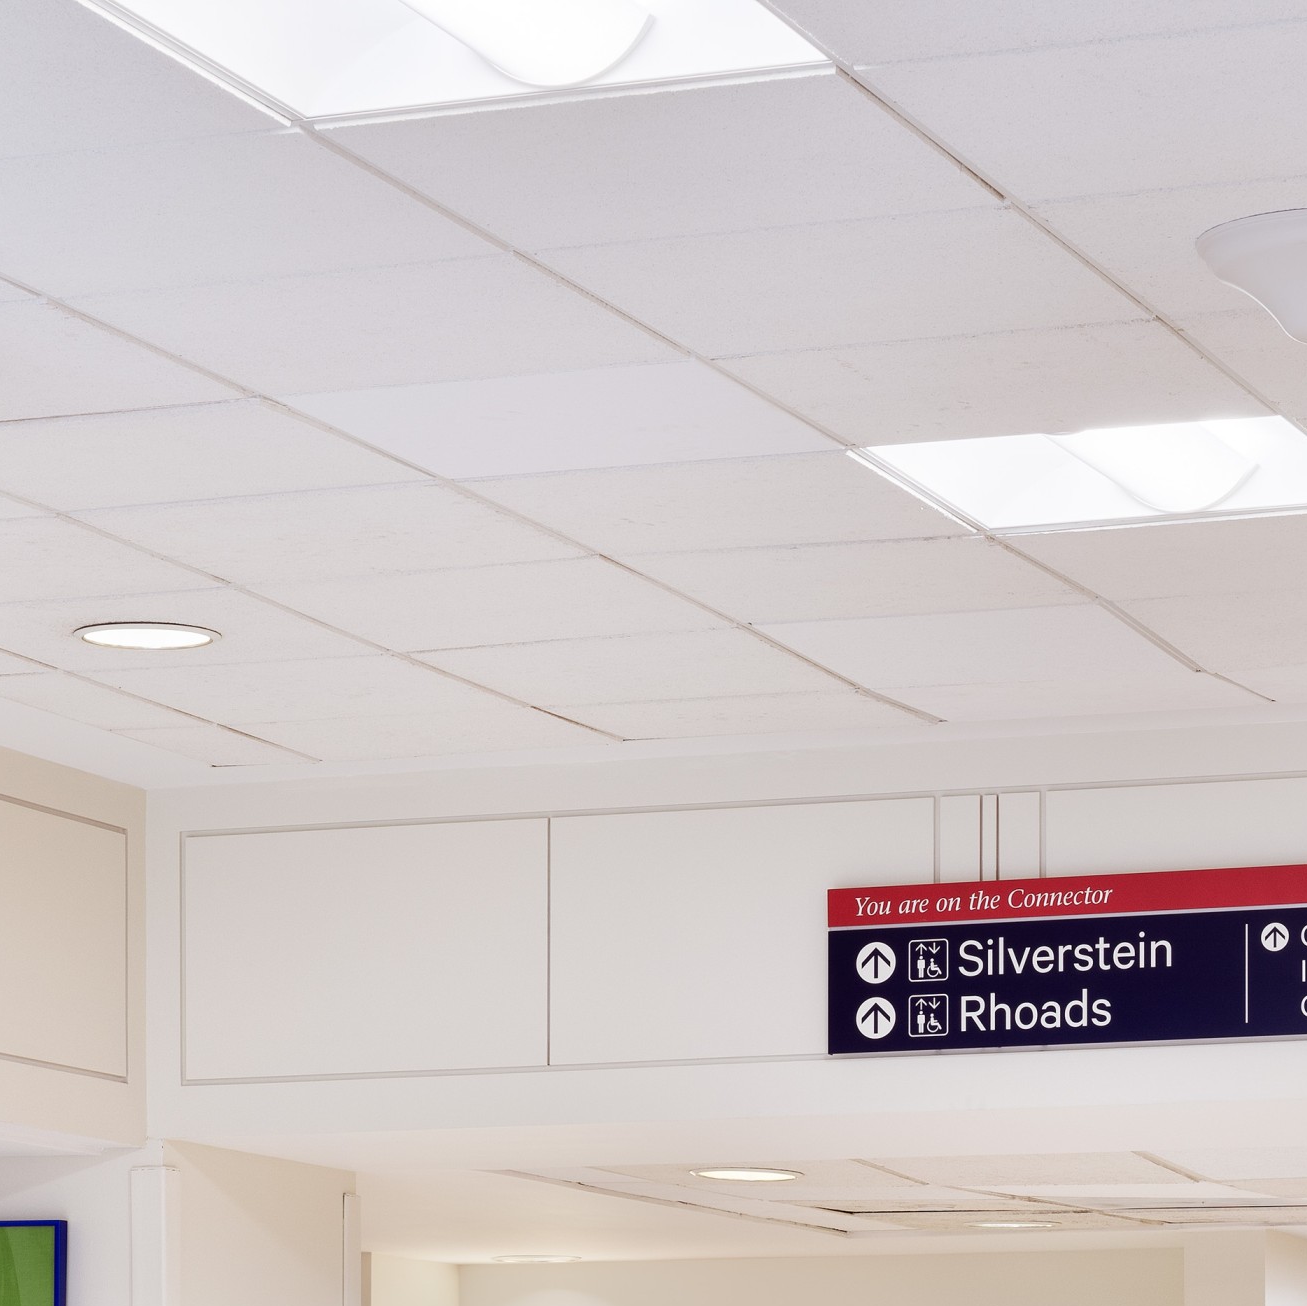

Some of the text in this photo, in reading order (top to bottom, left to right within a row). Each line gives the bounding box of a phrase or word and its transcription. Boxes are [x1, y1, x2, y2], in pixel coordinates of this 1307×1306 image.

[855, 886, 1113, 917] You are on the Connector
[958, 931, 1172, 977] Silverstein
[960, 988, 1112, 1032] Rhoads
